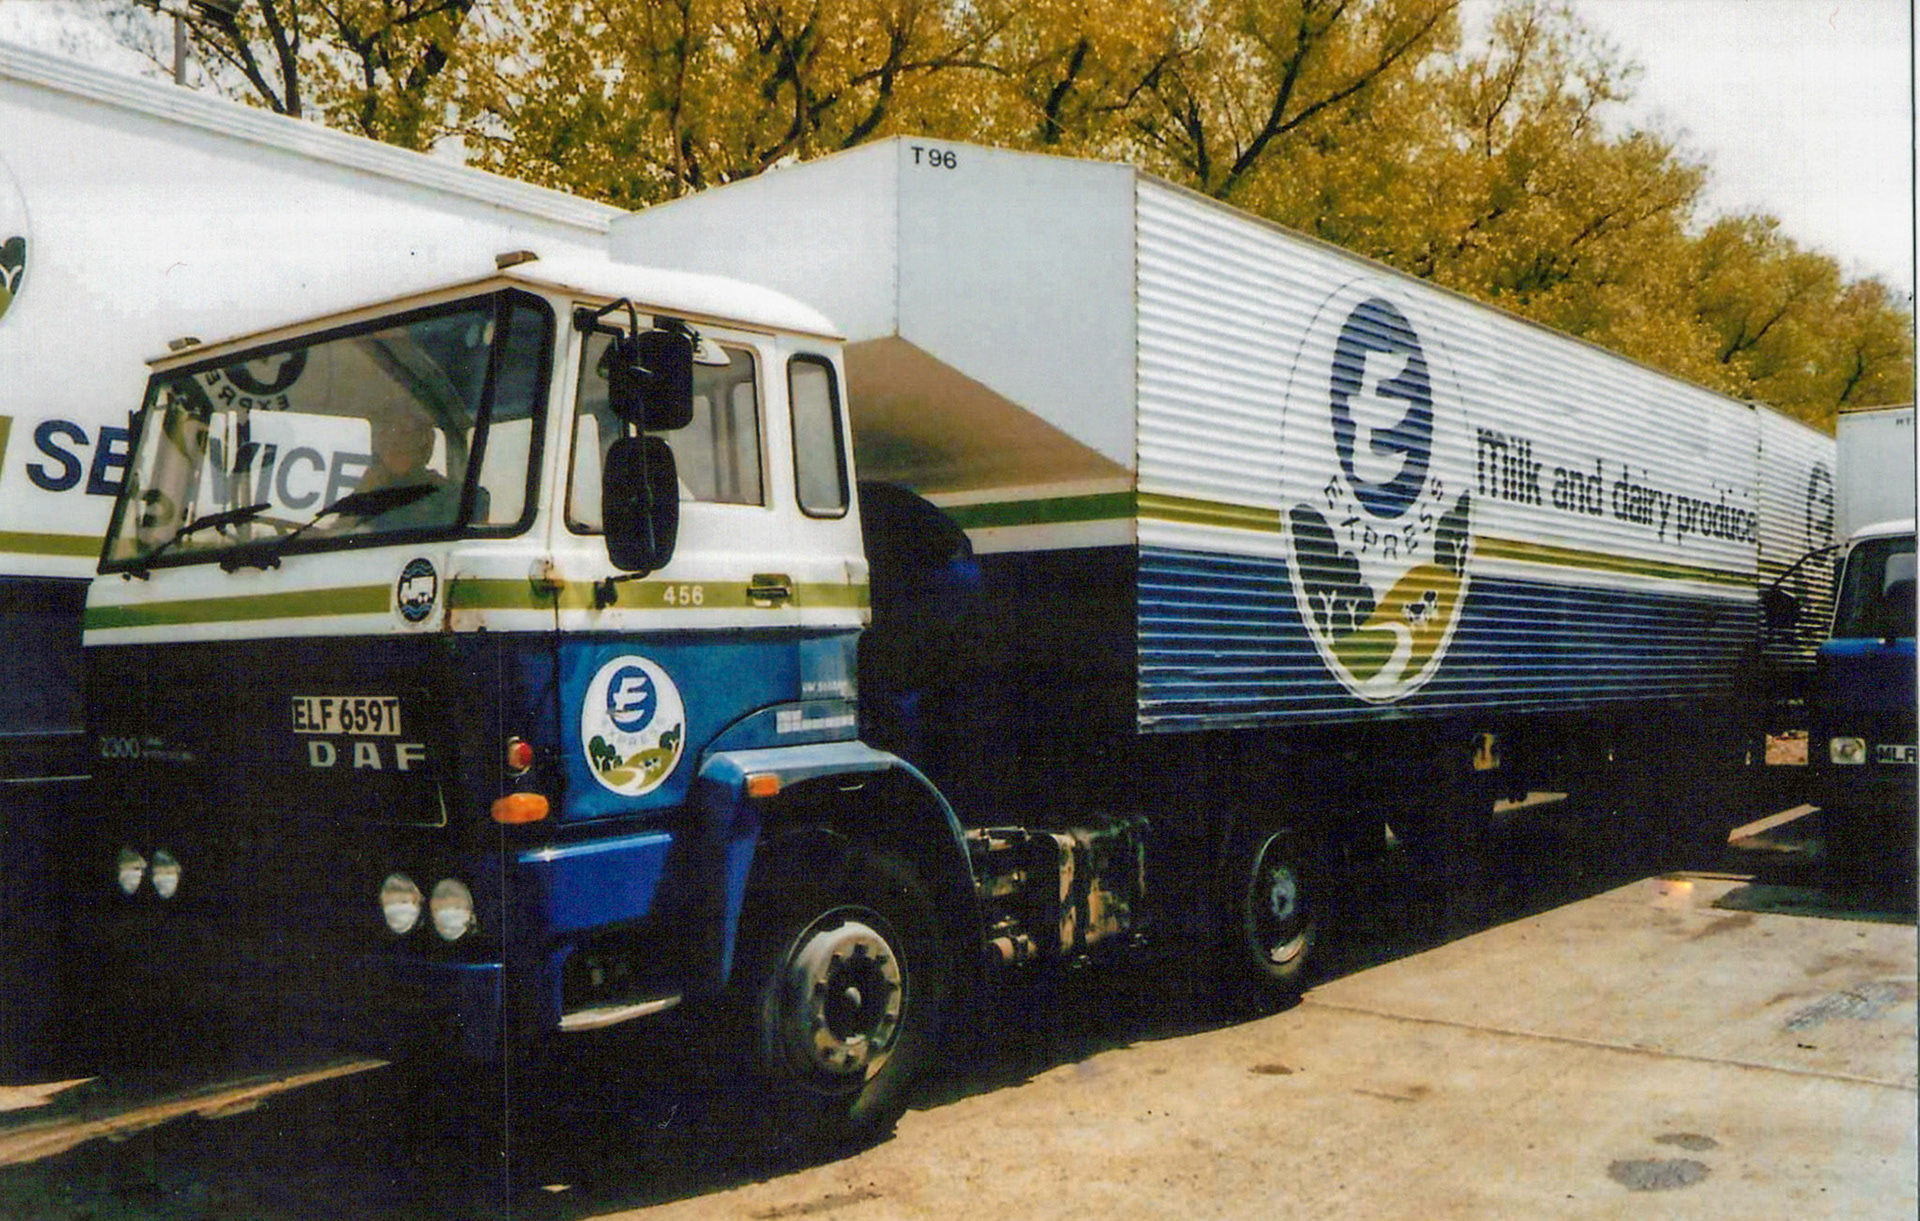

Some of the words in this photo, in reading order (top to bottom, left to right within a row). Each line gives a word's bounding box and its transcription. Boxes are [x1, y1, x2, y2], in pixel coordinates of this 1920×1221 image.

[26, 419, 373, 511] SEVICE
[1477, 428, 1543, 507] milk
[1551, 458, 1603, 517] and
[1612, 464, 1673, 543] dairy
[1677, 489, 1758, 545] produce
[663, 585, 704, 606] 456
[294, 699, 334, 731] ELF
[340, 699, 399, 732] 659T
[308, 741, 426, 771] DAF
